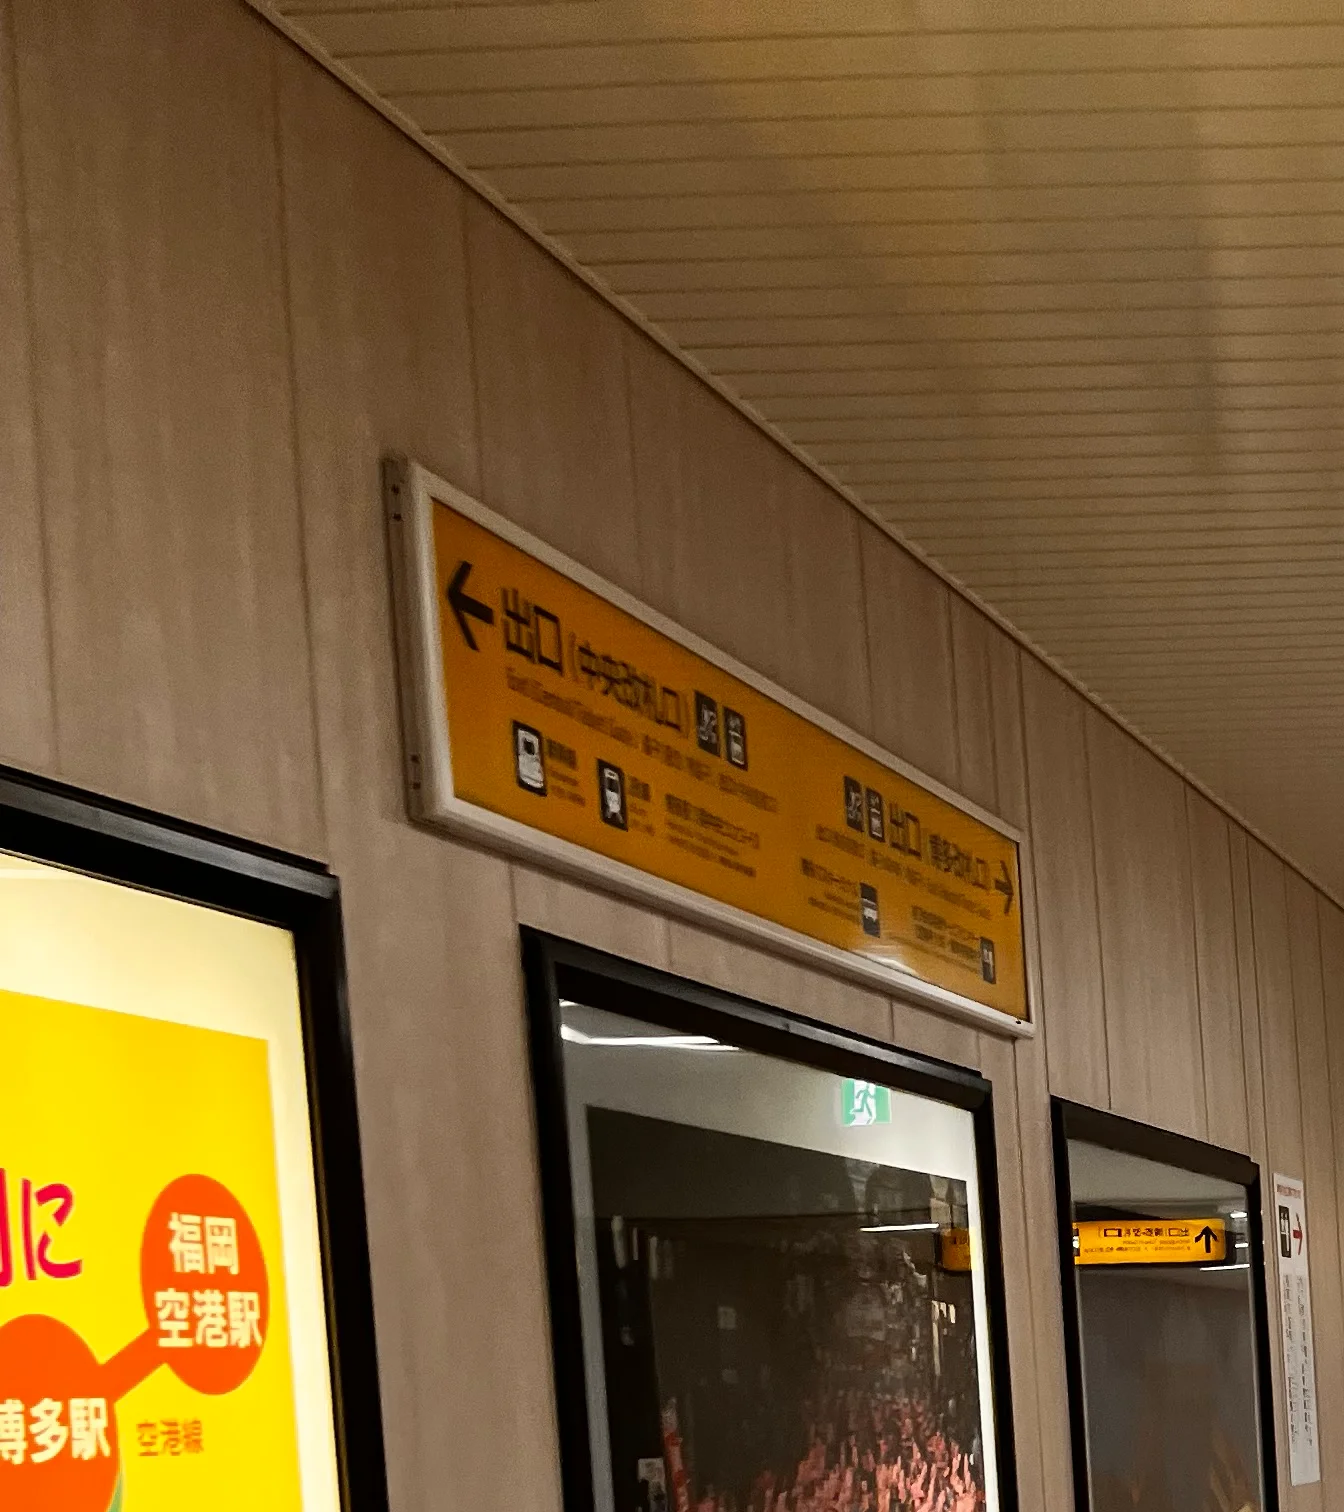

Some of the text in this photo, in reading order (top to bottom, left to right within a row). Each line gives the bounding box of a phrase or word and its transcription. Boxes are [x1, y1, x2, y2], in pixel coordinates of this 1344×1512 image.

[0, 1166, 83, 1287] に
[168, 1211, 241, 1276] 福岡
[154, 1287, 263, 1350] 空港駅
[135, 1418, 205, 1458] 空港線
